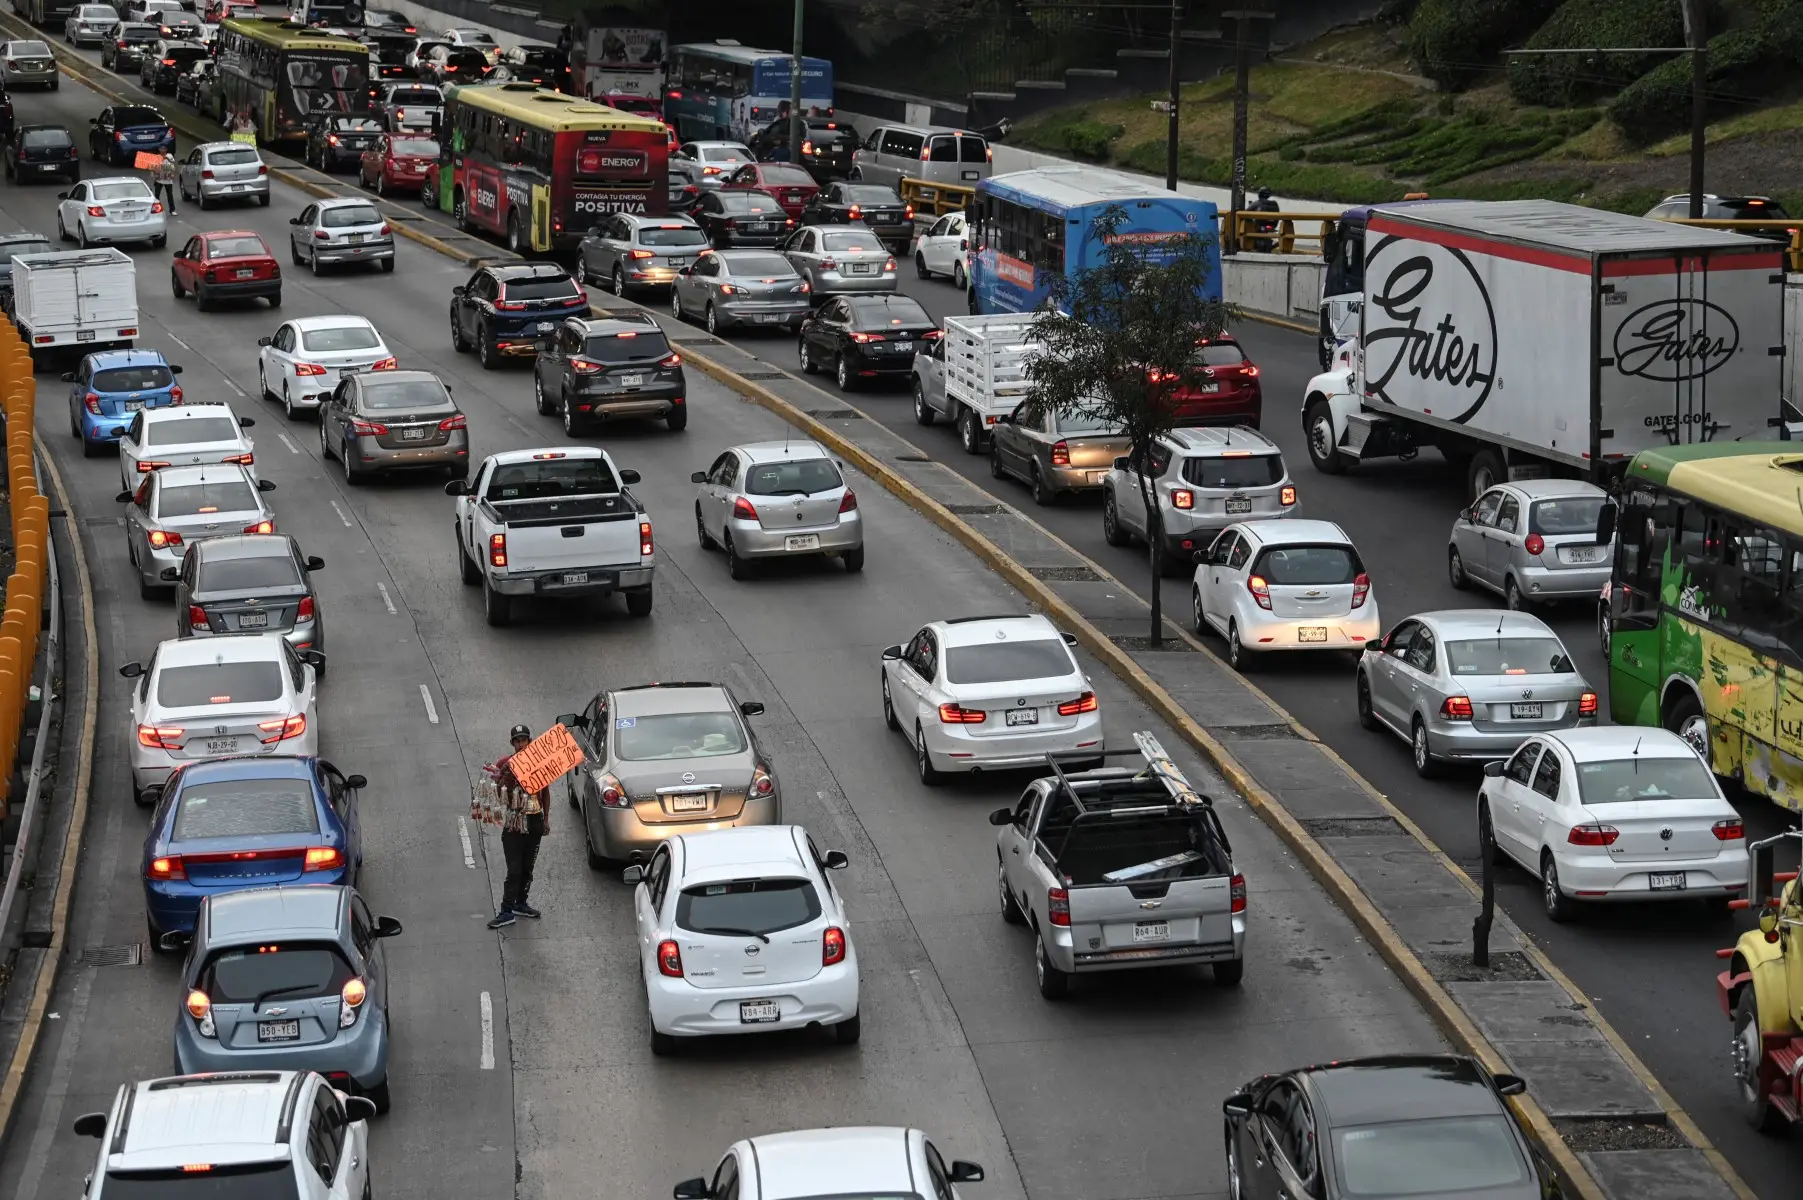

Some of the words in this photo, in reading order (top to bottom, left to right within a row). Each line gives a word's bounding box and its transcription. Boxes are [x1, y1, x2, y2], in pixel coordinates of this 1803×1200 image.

[601, 157, 641, 168] ENERGY
[477, 187, 496, 209] ENERGY
[575, 192, 609, 201] CONTAGIA
[618, 193, 647, 201] ENERGÍA
[575, 201, 646, 214] POSITIVA
[1366, 255, 1482, 393] Gates
[1618, 309, 1726, 376] Gates
[520, 758, 563, 796] BOTANA
